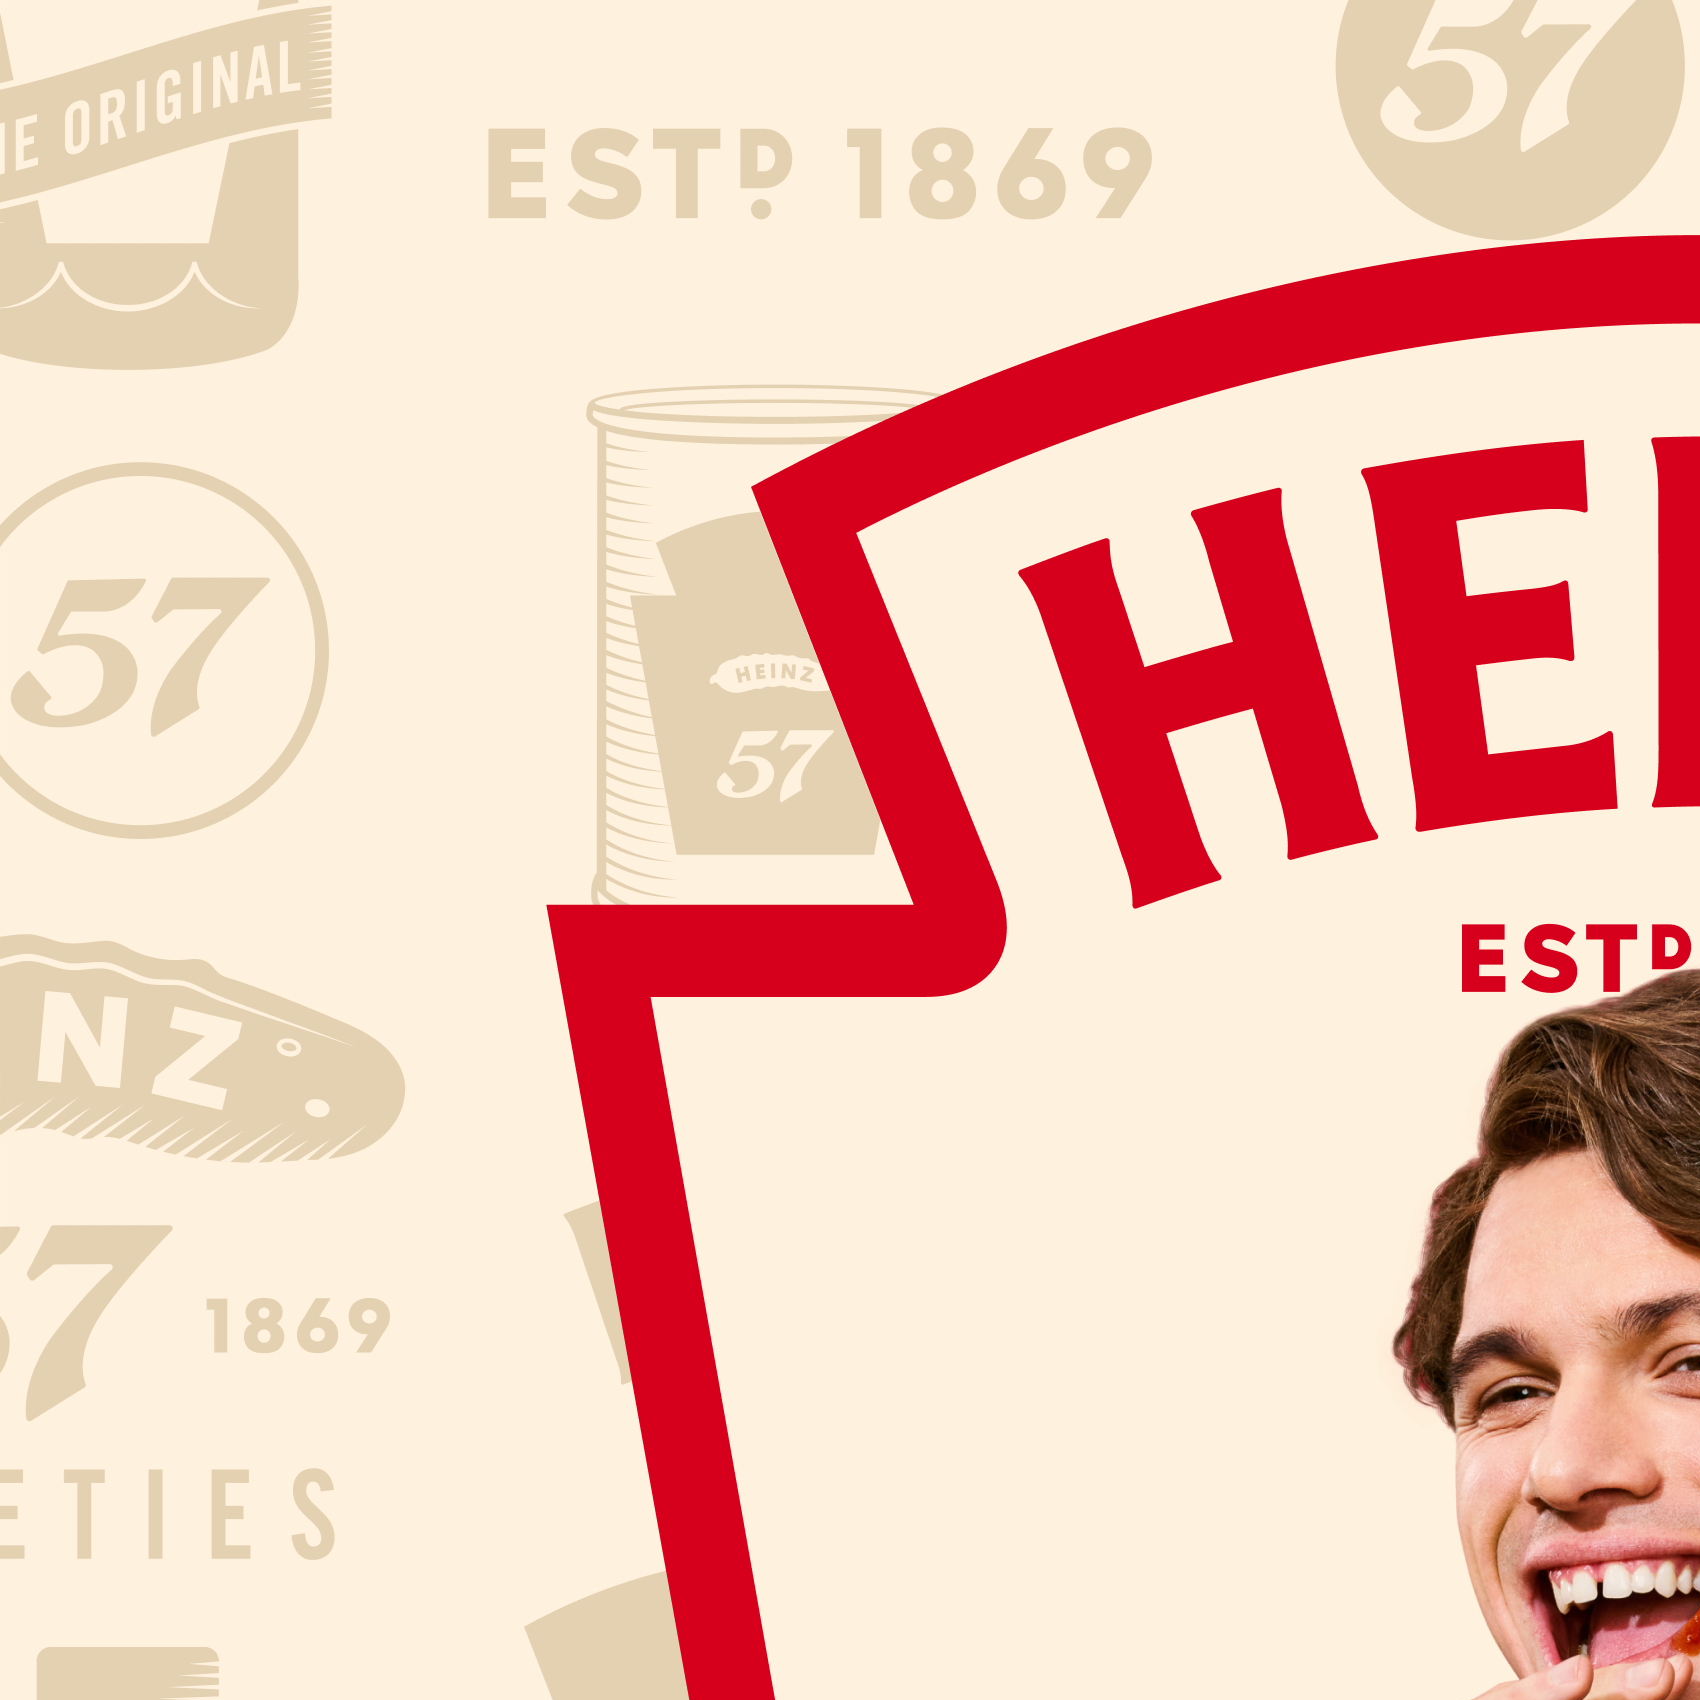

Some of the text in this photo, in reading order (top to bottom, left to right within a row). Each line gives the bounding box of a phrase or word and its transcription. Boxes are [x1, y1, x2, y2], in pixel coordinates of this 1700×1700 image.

[65, 41, 300, 154] ORIGINAL
[1378, 0, 1637, 153] 57
[847, 128, 1152, 219] 1869
[11, 578, 270, 737] 57
[736, 664, 814, 682] HEINZ
[717, 730, 834, 802] 57
[0, 1225, 390, 1421] 7 1869
